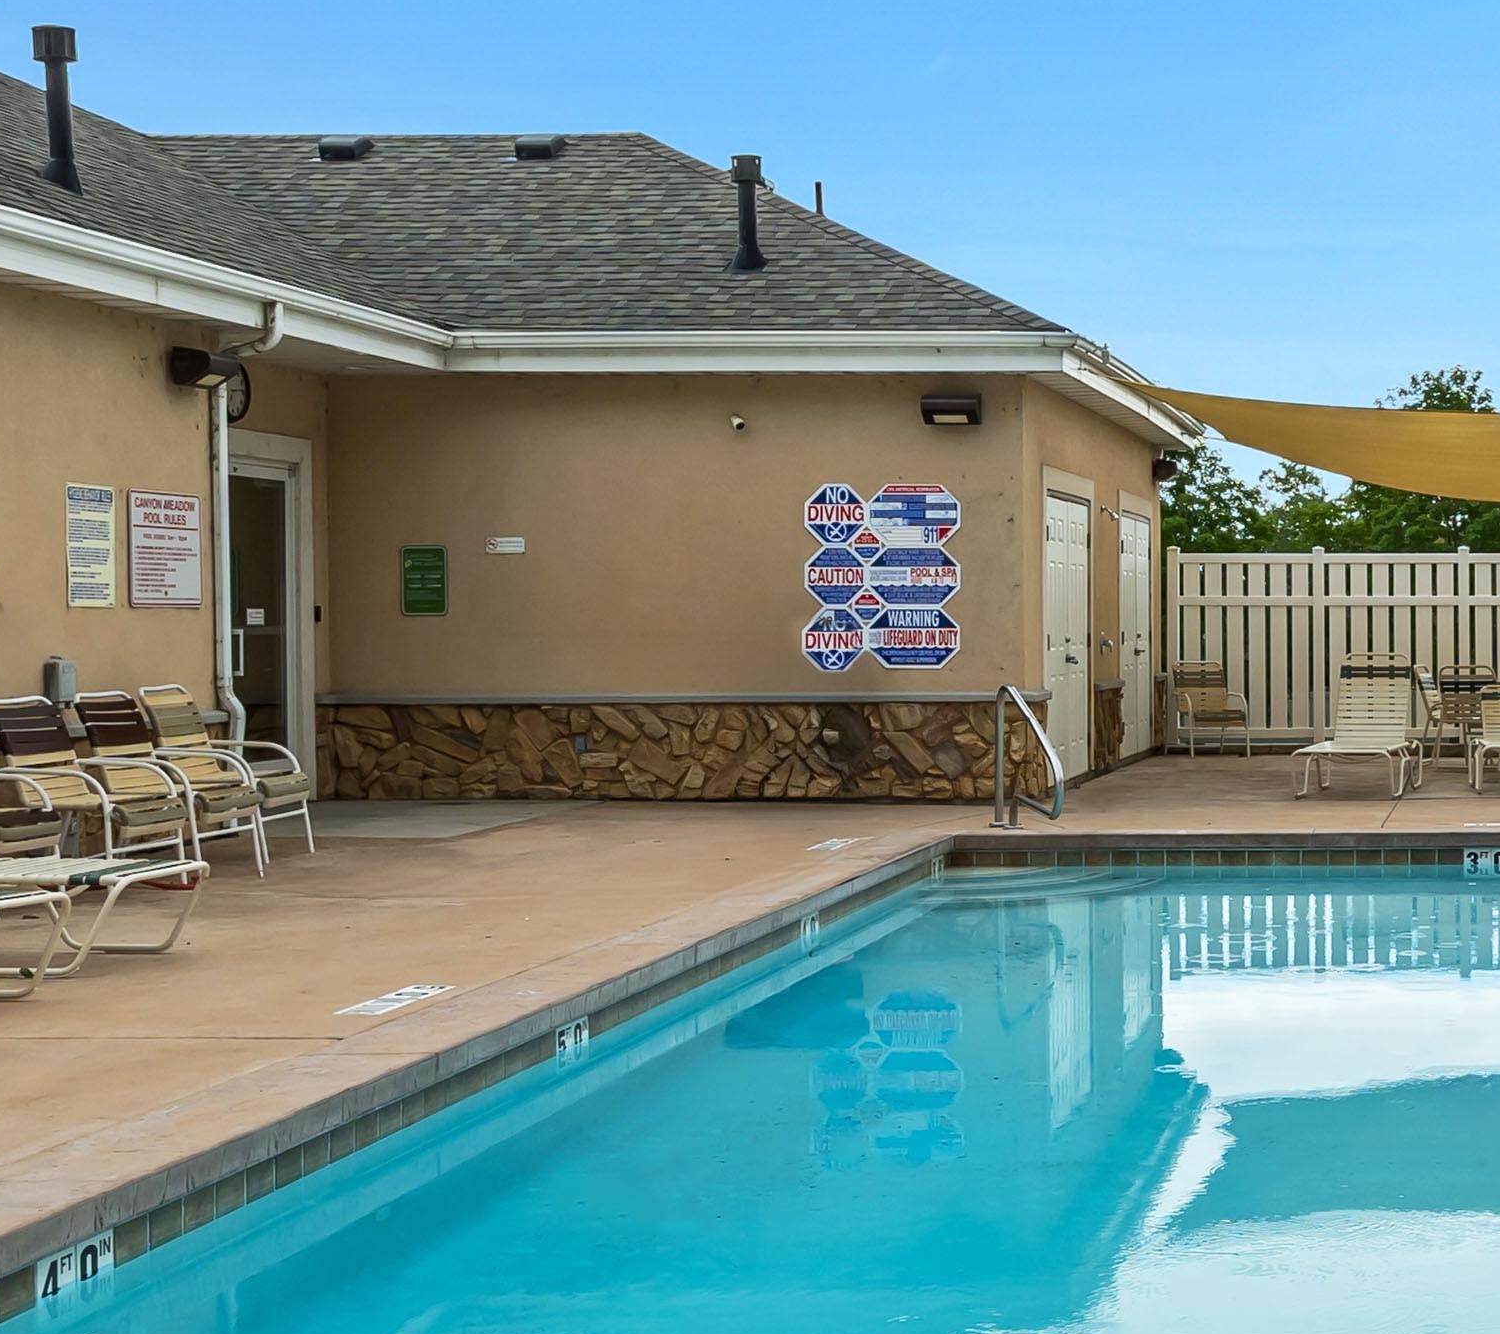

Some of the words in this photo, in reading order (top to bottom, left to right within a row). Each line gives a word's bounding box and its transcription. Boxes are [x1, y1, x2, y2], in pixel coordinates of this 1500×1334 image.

[825, 486, 849, 504] NO
[134, 497, 162, 510] CANYON
[163, 500, 196, 512] MEADOW
[143, 512, 162, 524] POOL
[164, 514, 187, 526] RULES
[808, 505, 864, 522] DIVING
[923, 527, 939, 544] 911
[808, 568, 864, 584] CAUTION
[910, 567, 933, 578] POOL
[934, 568, 940, 577] &
[941, 567, 957, 578] SPA
[887, 610, 940, 627] WARNING
[883, 630, 923, 646] LIFEGUARD
[925, 630, 937, 646] ON
[938, 630, 958, 647] DUTY
[41, 1259, 61, 1299] 4
[60, 1252, 73, 1275] FT
[80, 1244, 99, 1282] 0
[99, 1236, 111, 1257] IN
